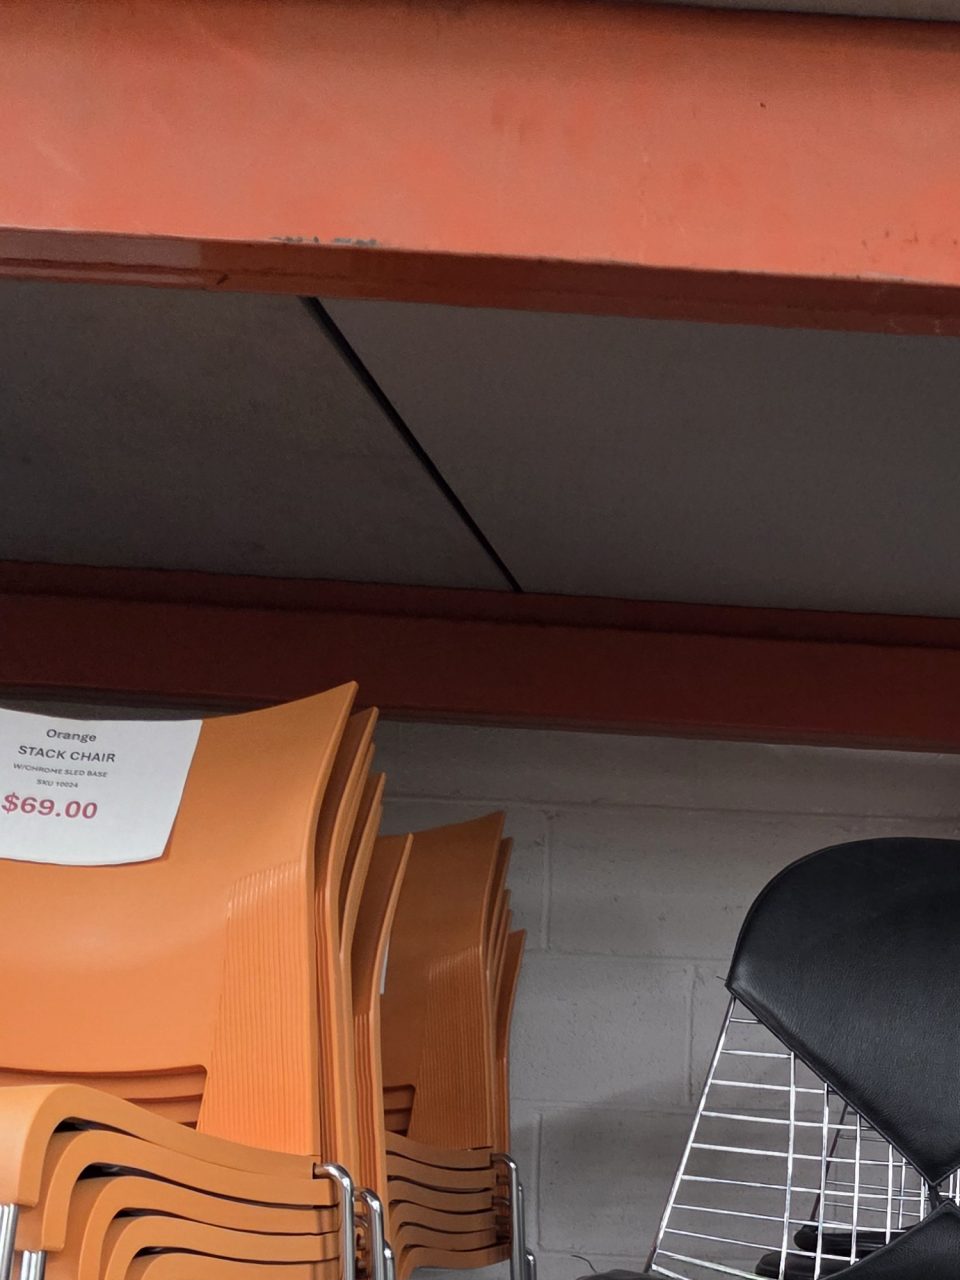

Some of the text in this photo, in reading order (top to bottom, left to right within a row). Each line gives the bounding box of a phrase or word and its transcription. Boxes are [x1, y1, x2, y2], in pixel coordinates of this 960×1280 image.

[46, 728, 97, 743] Orange
[18, 745, 116, 763] STACK CHAIR
[13, 762, 63, 775] W/CHROME
[87, 770, 108, 778] BASE
[36, 779, 54, 787] SKU
[1, 792, 98, 819] $69.00
